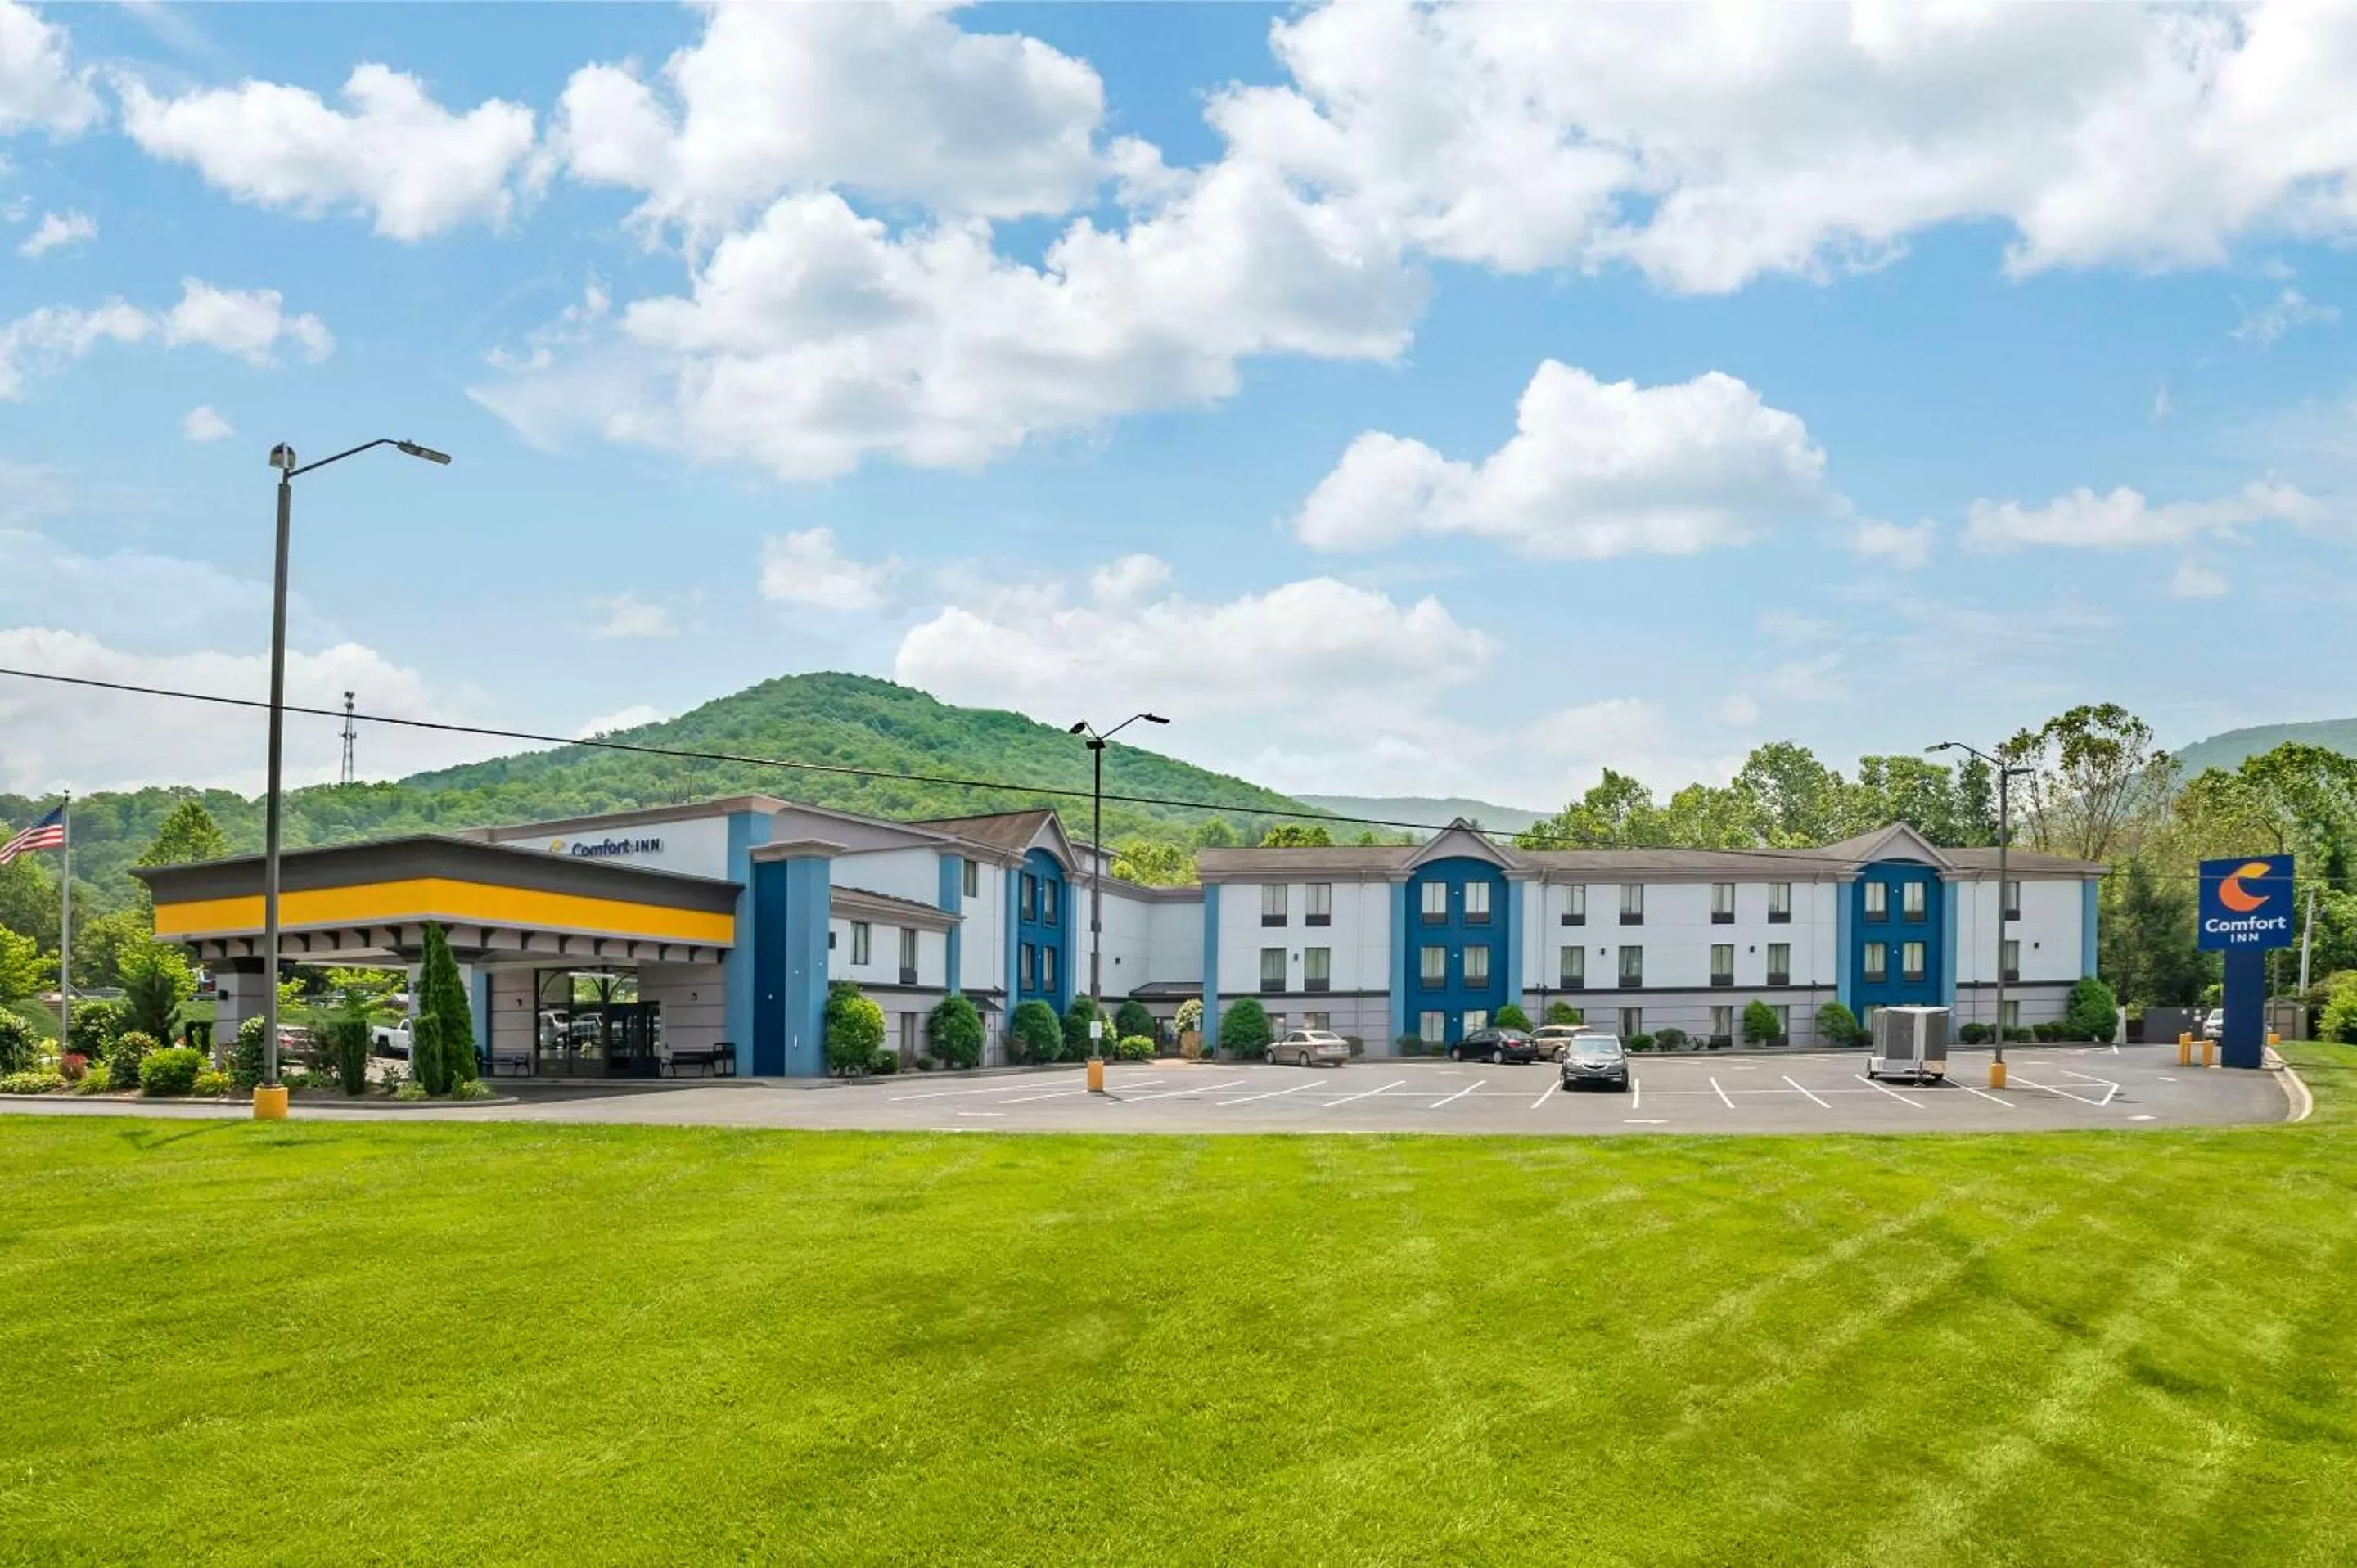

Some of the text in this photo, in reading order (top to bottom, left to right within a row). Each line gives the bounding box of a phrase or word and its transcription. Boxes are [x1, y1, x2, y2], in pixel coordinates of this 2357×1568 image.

[573, 838, 660, 857] Comfort INN
[2206, 916, 2287, 932] Comfort
[2230, 933, 2259, 943] INN
